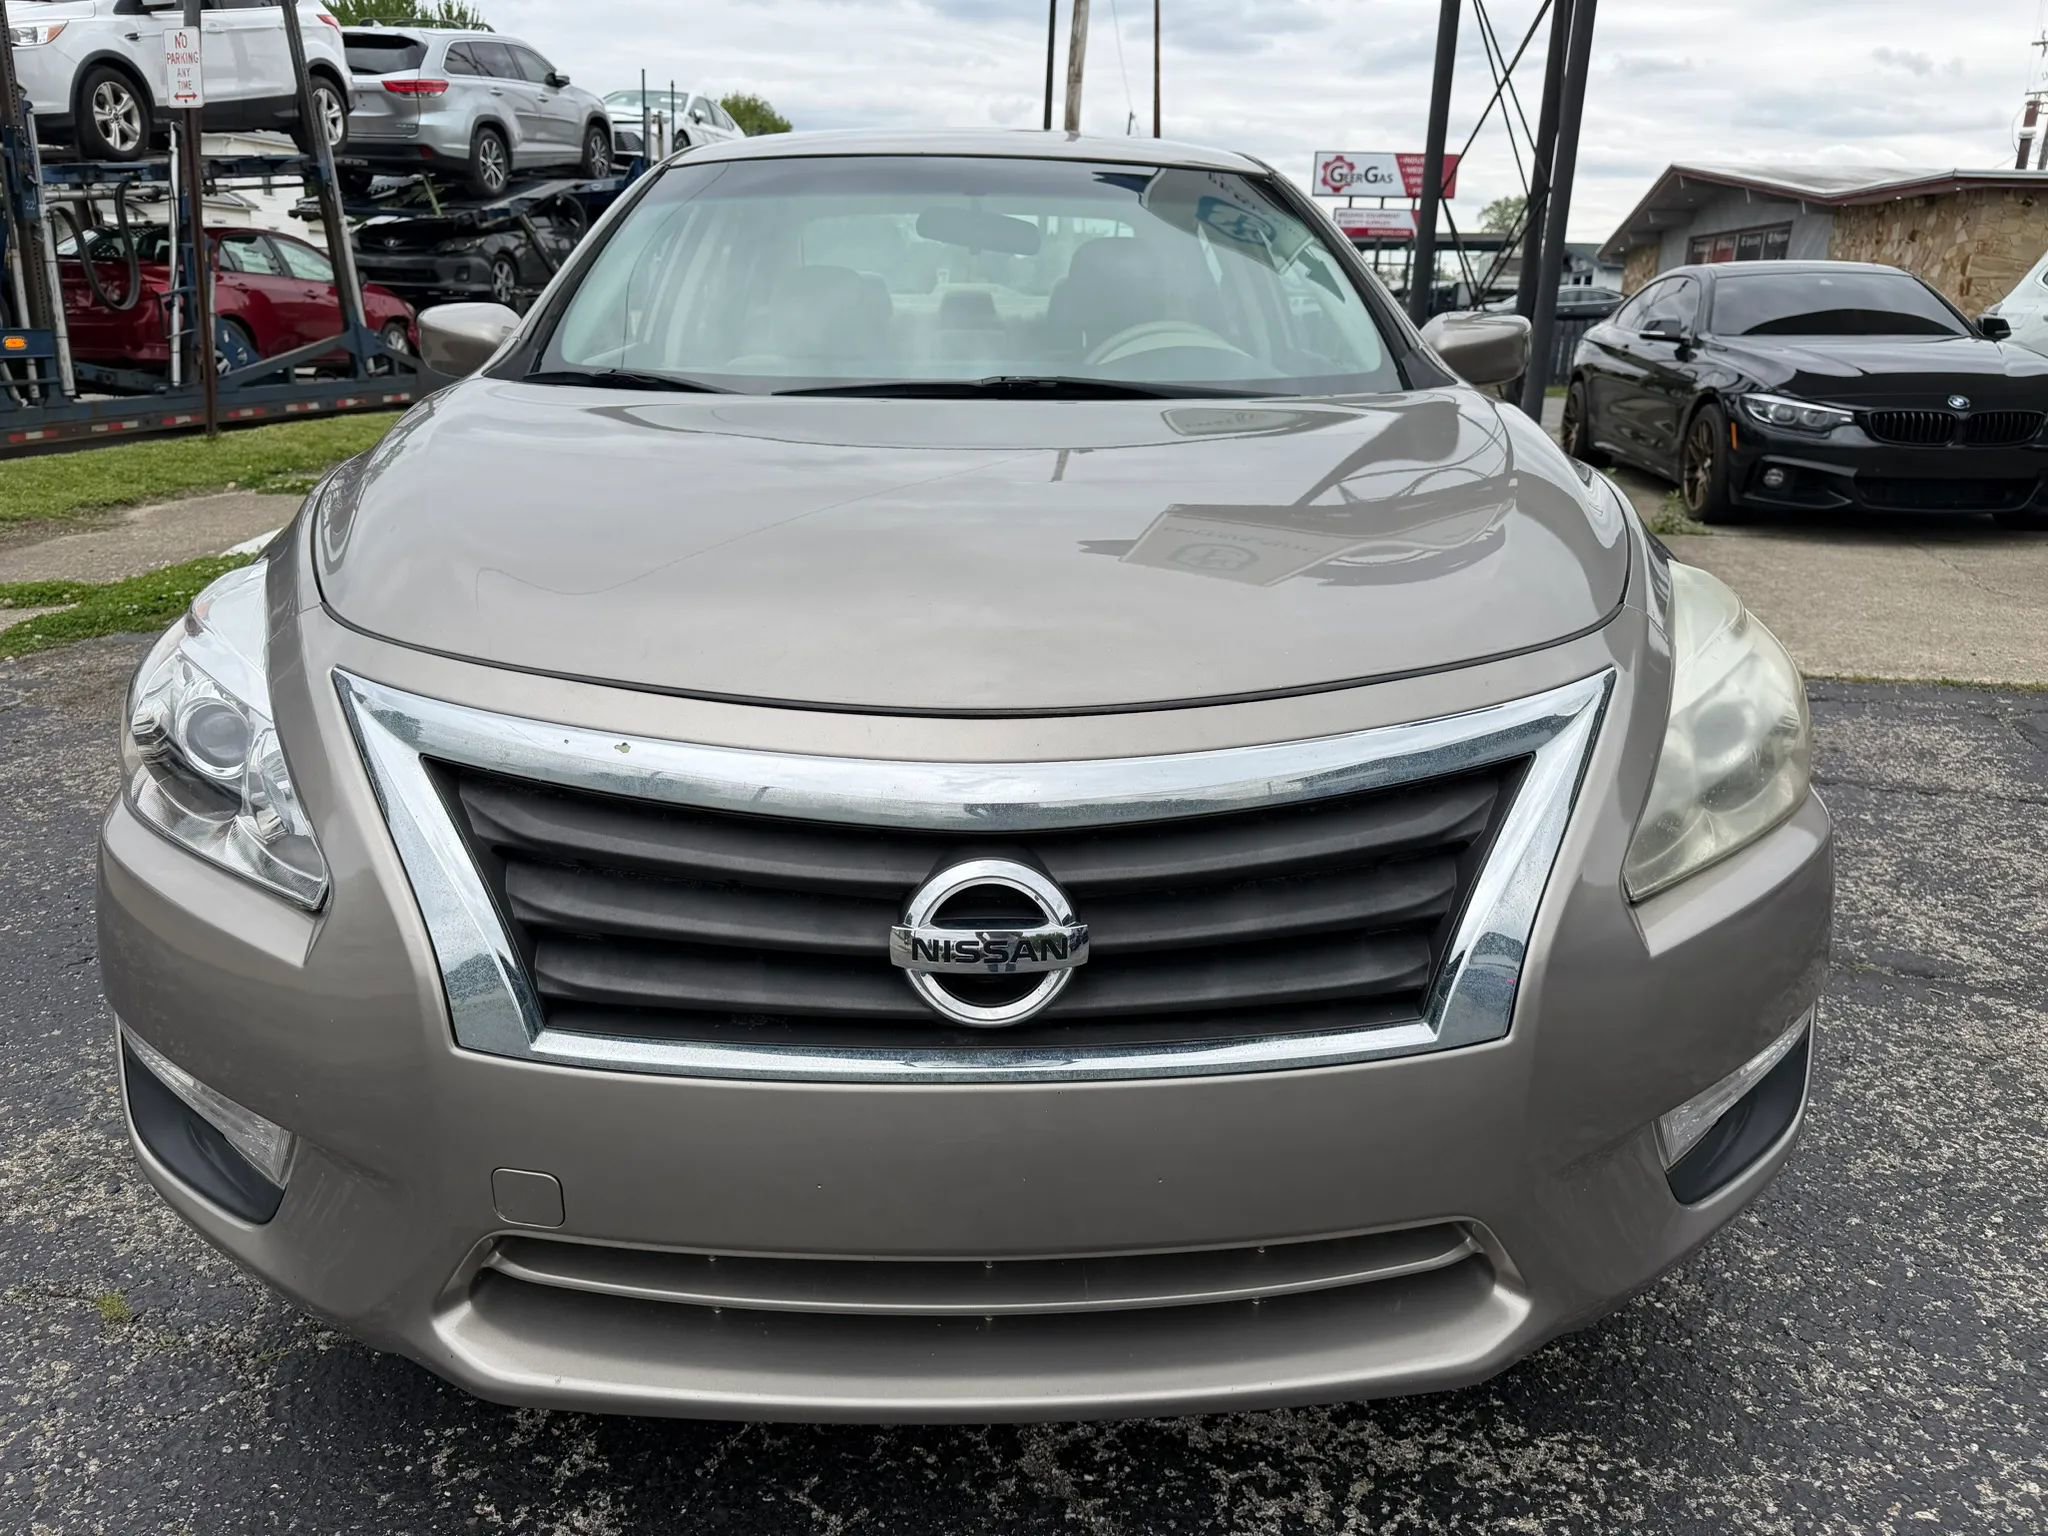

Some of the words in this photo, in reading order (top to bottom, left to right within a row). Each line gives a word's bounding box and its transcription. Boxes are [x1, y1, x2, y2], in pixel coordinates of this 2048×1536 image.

[175, 35, 187, 48] NO
[167, 52, 198, 64] PARKING
[177, 68, 190, 77] ANY
[178, 81, 192, 90] TIME
[911, 938, 1068, 963] NISSAN
